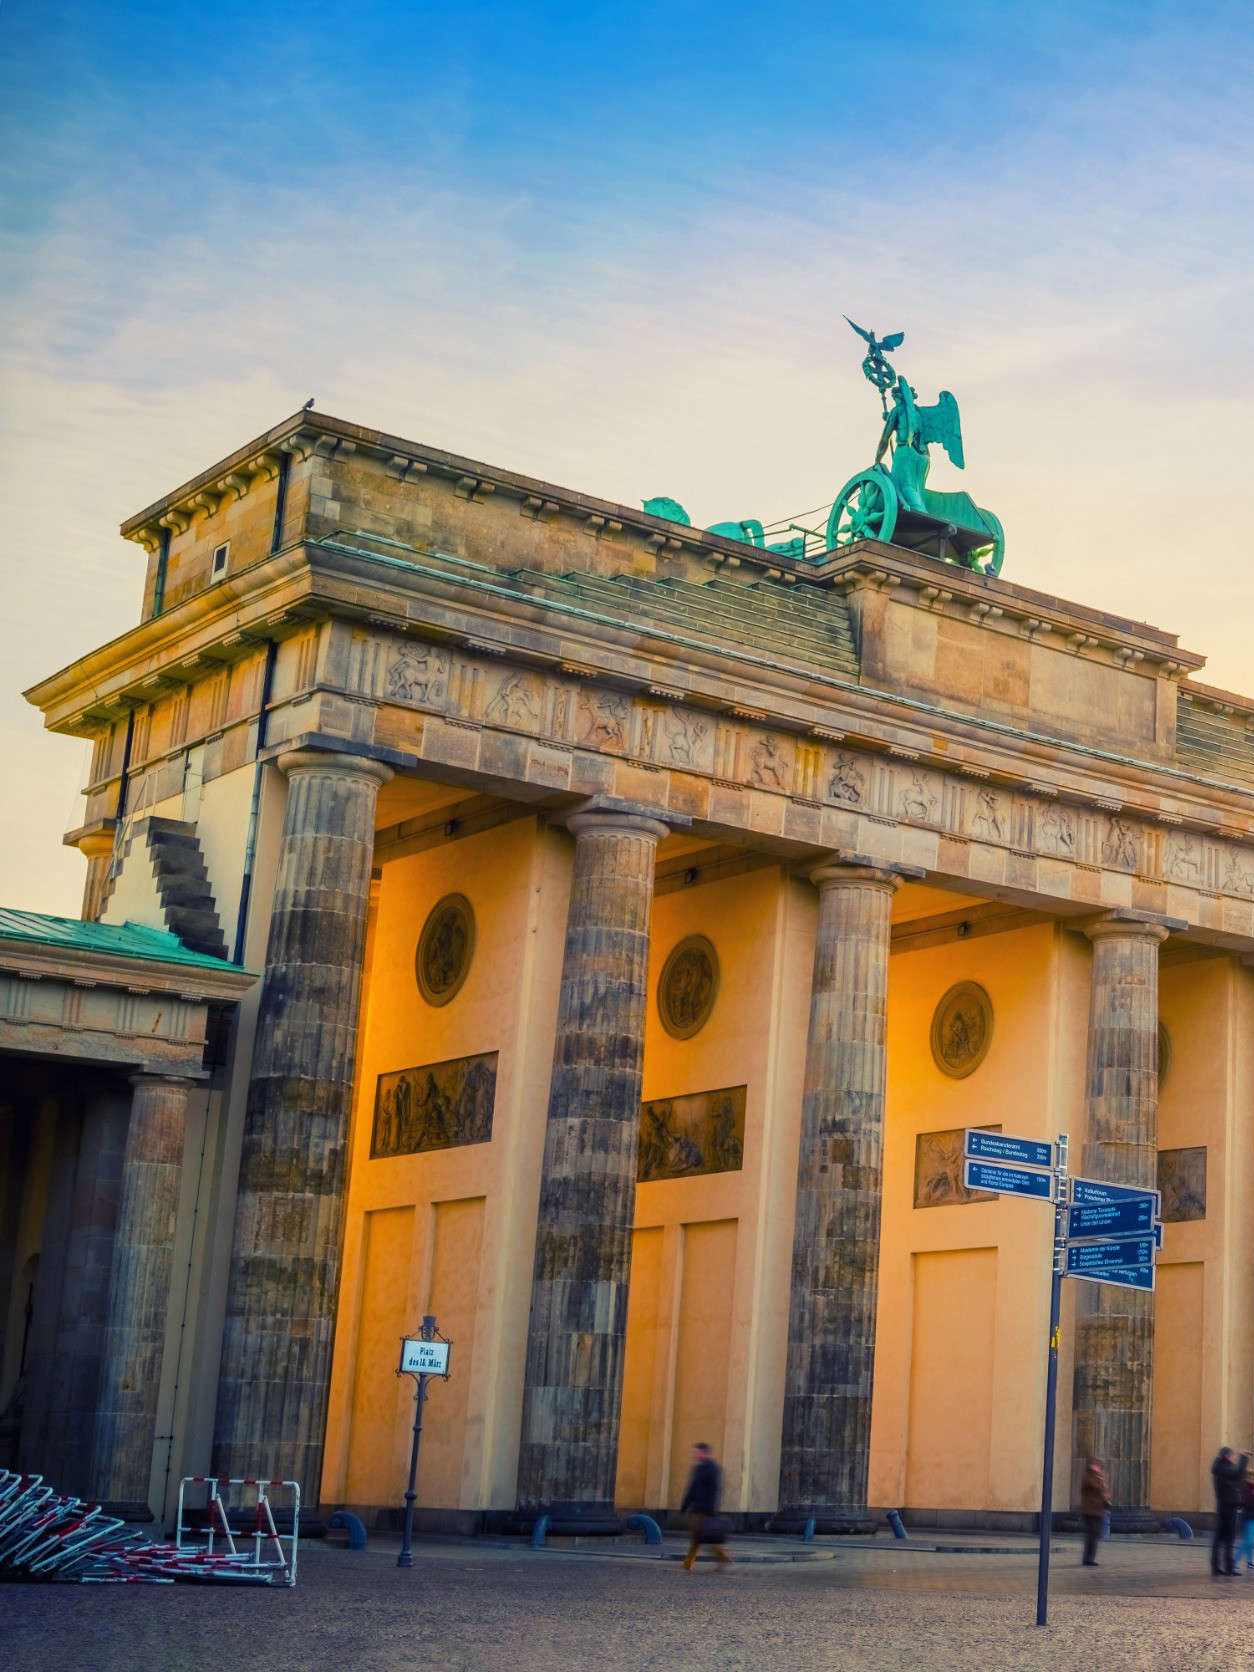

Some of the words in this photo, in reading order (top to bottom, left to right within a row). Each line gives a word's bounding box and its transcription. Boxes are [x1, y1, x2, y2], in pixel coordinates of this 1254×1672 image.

[981, 1145, 1001, 1154] Reichstag
[420, 1347, 434, 1355] Platz
[428, 1359, 441, 1367] März
